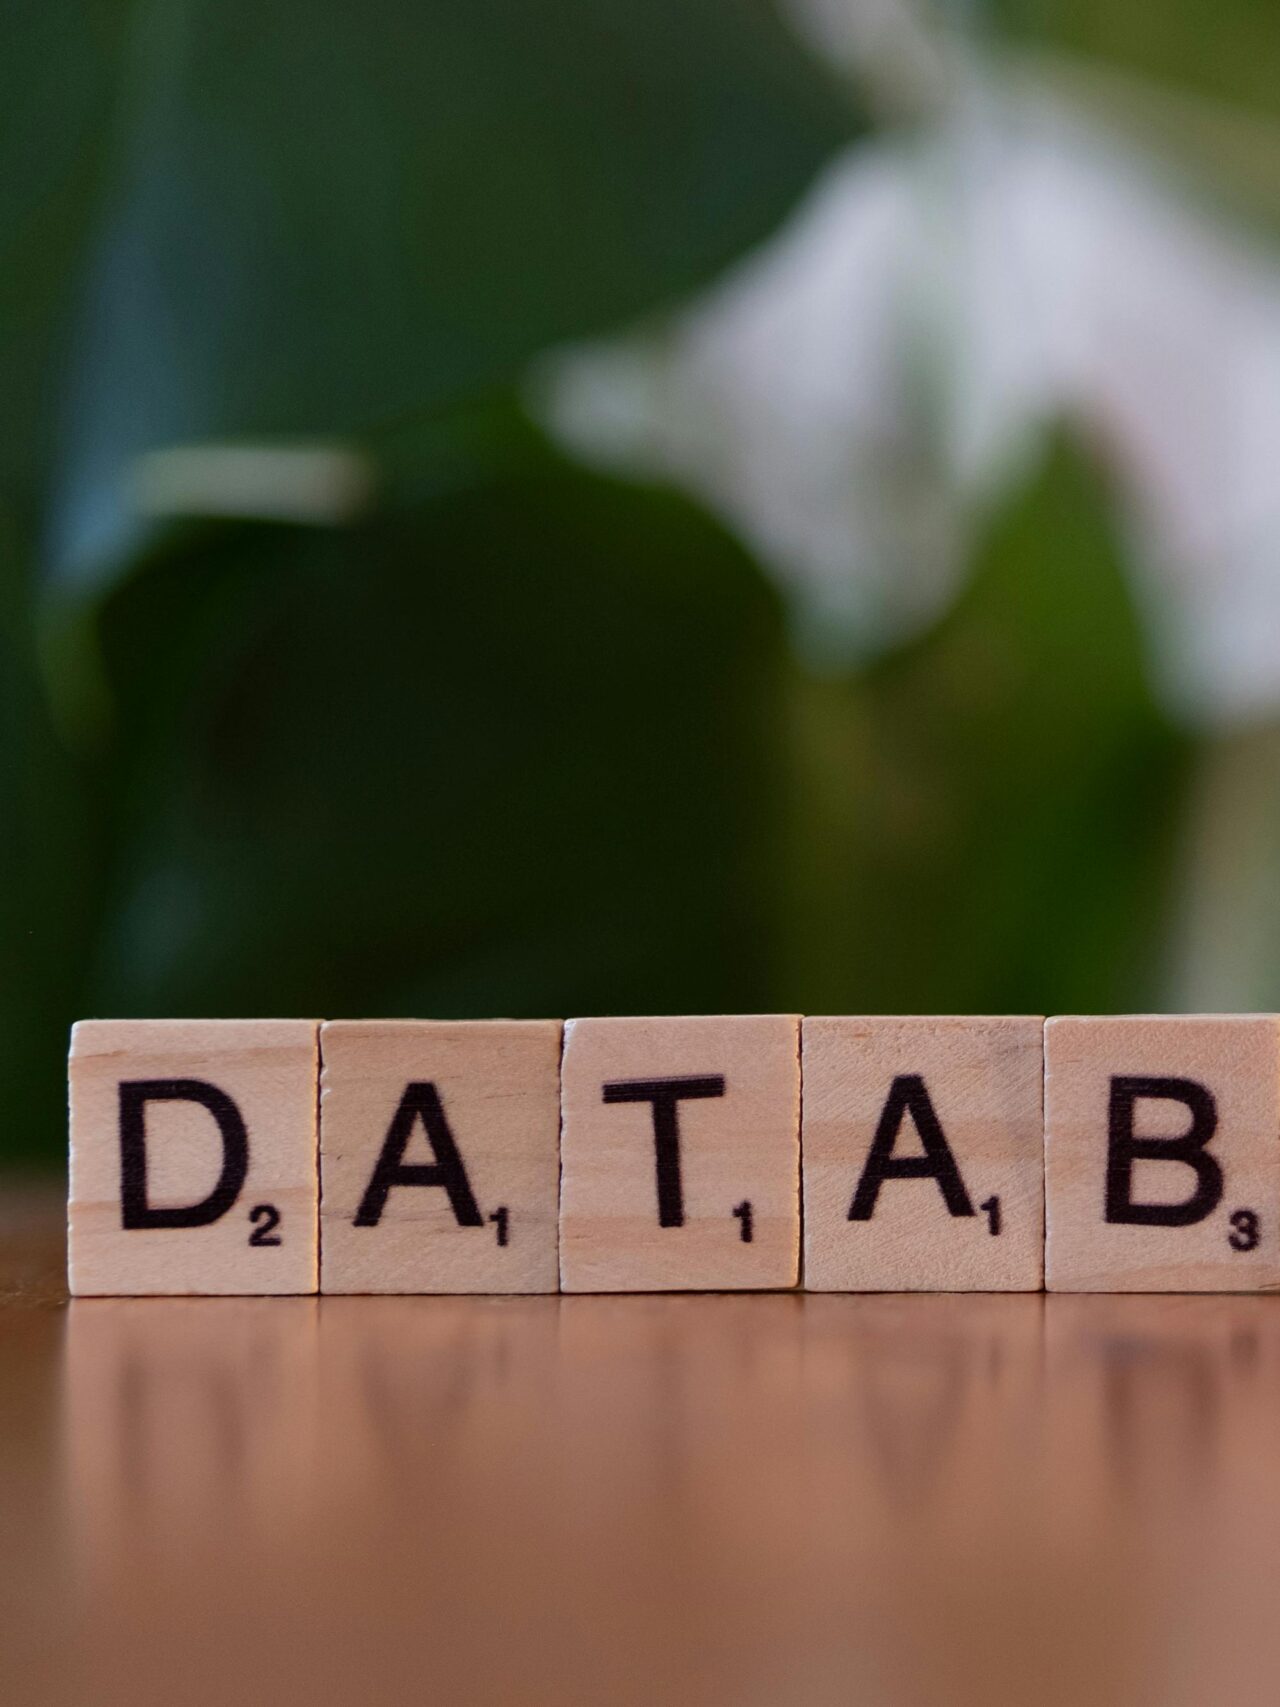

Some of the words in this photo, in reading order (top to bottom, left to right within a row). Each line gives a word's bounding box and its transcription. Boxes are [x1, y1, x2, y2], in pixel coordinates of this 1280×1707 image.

[249, 1205, 281, 1248] 2
[488, 1206, 510, 1248] 1
[732, 1200, 754, 1244] 1
[979, 1195, 1002, 1237] 1
[1227, 1209, 1262, 1253] 3
